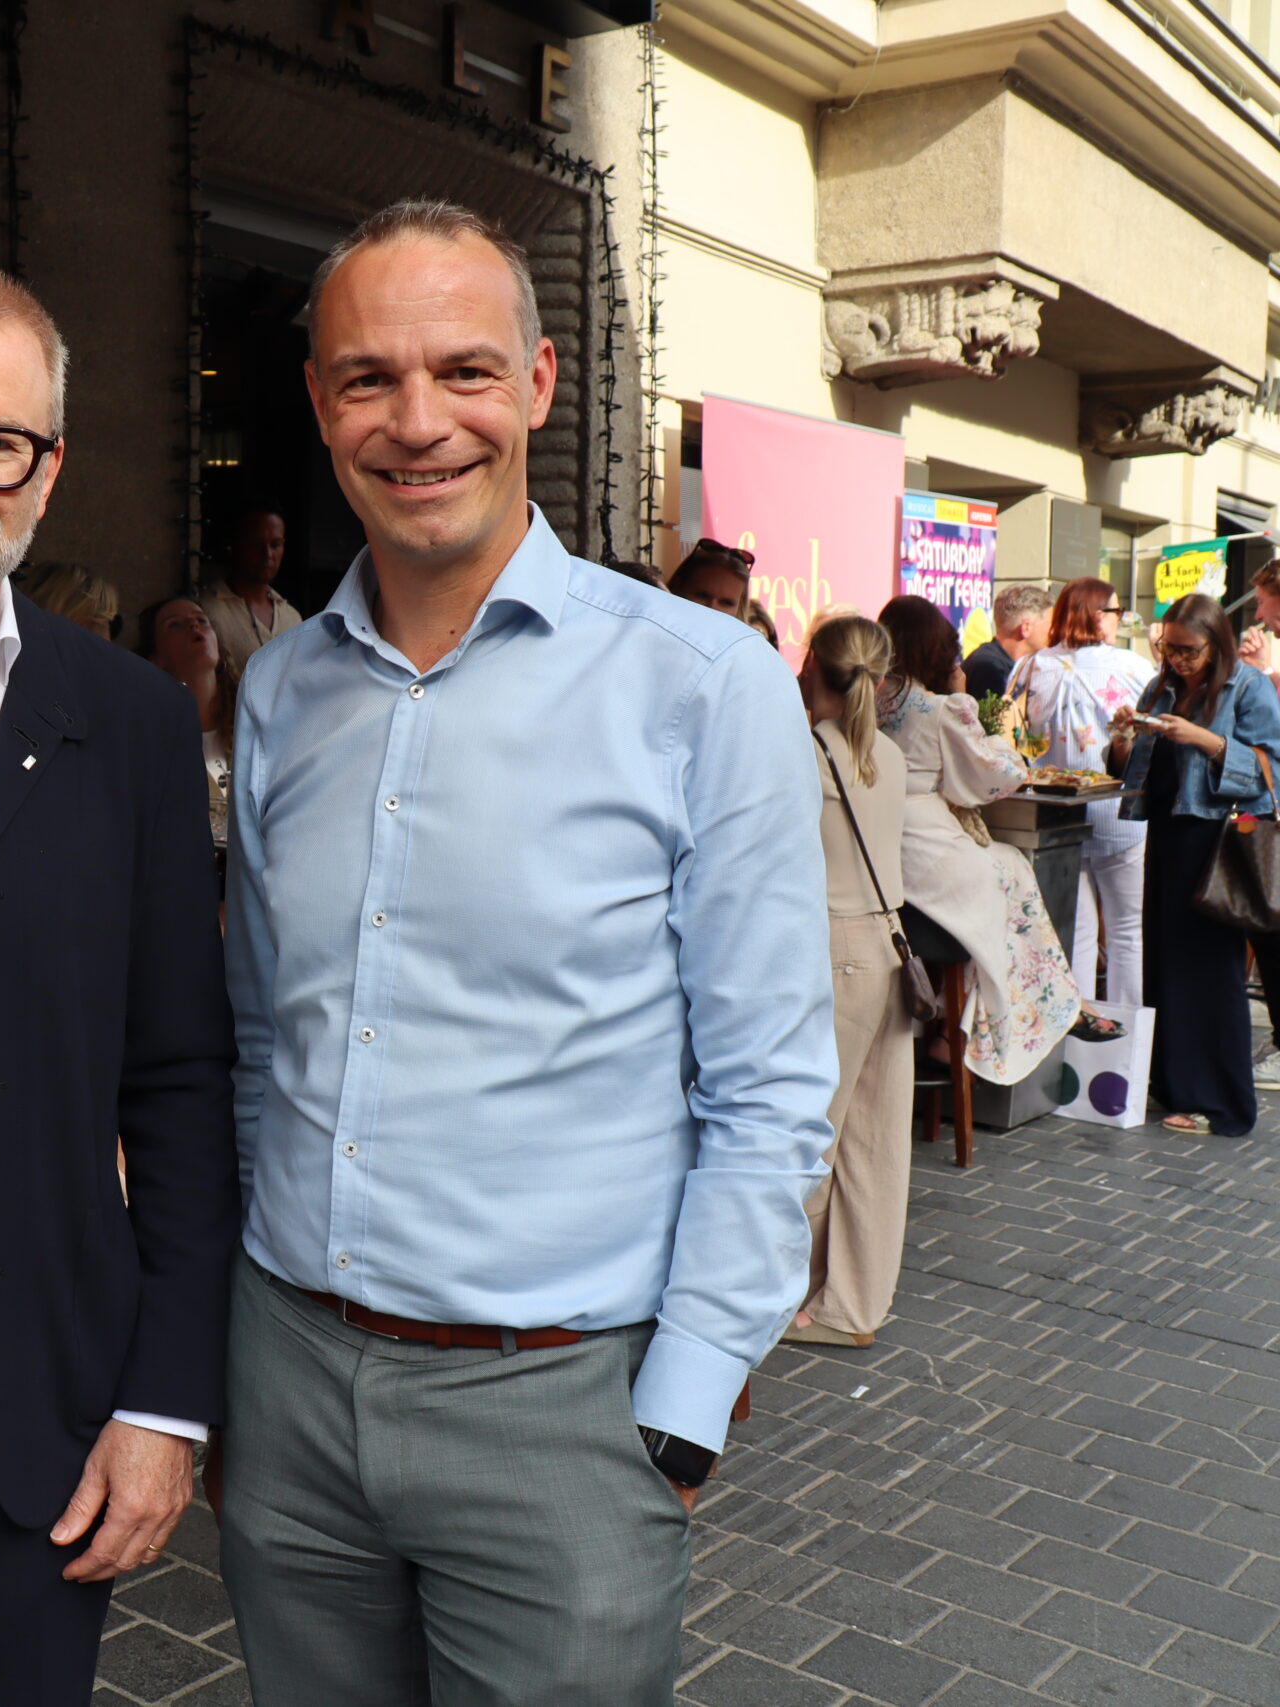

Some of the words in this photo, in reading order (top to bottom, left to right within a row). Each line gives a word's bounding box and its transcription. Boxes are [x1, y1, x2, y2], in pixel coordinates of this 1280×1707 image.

[916, 538, 986, 574] SATURDAY
[738, 531, 832, 646] resh
[906, 571, 954, 606] NIGHT
[954, 576, 993, 609] FEVER
